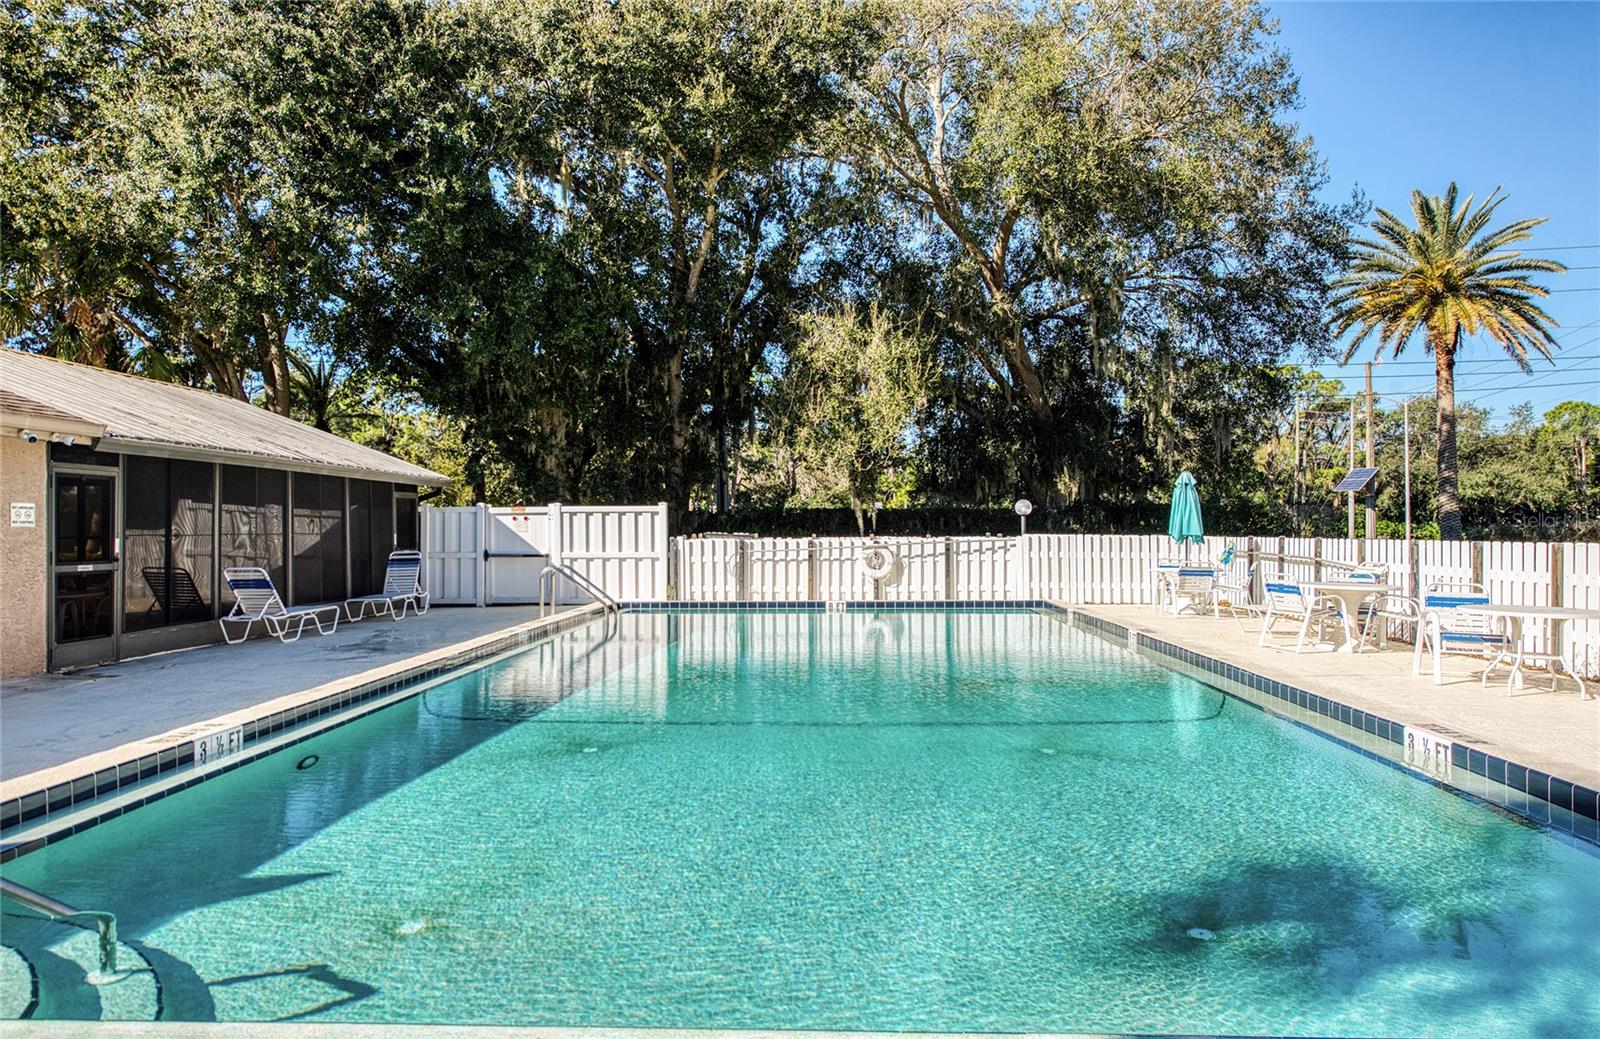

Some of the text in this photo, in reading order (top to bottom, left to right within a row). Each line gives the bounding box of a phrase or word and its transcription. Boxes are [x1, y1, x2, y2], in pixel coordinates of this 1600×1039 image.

[200, 740, 207, 757] 3
[228, 729, 242, 750] FT
[1408, 732, 1414, 751] 3
[1435, 741, 1450, 762] FT
